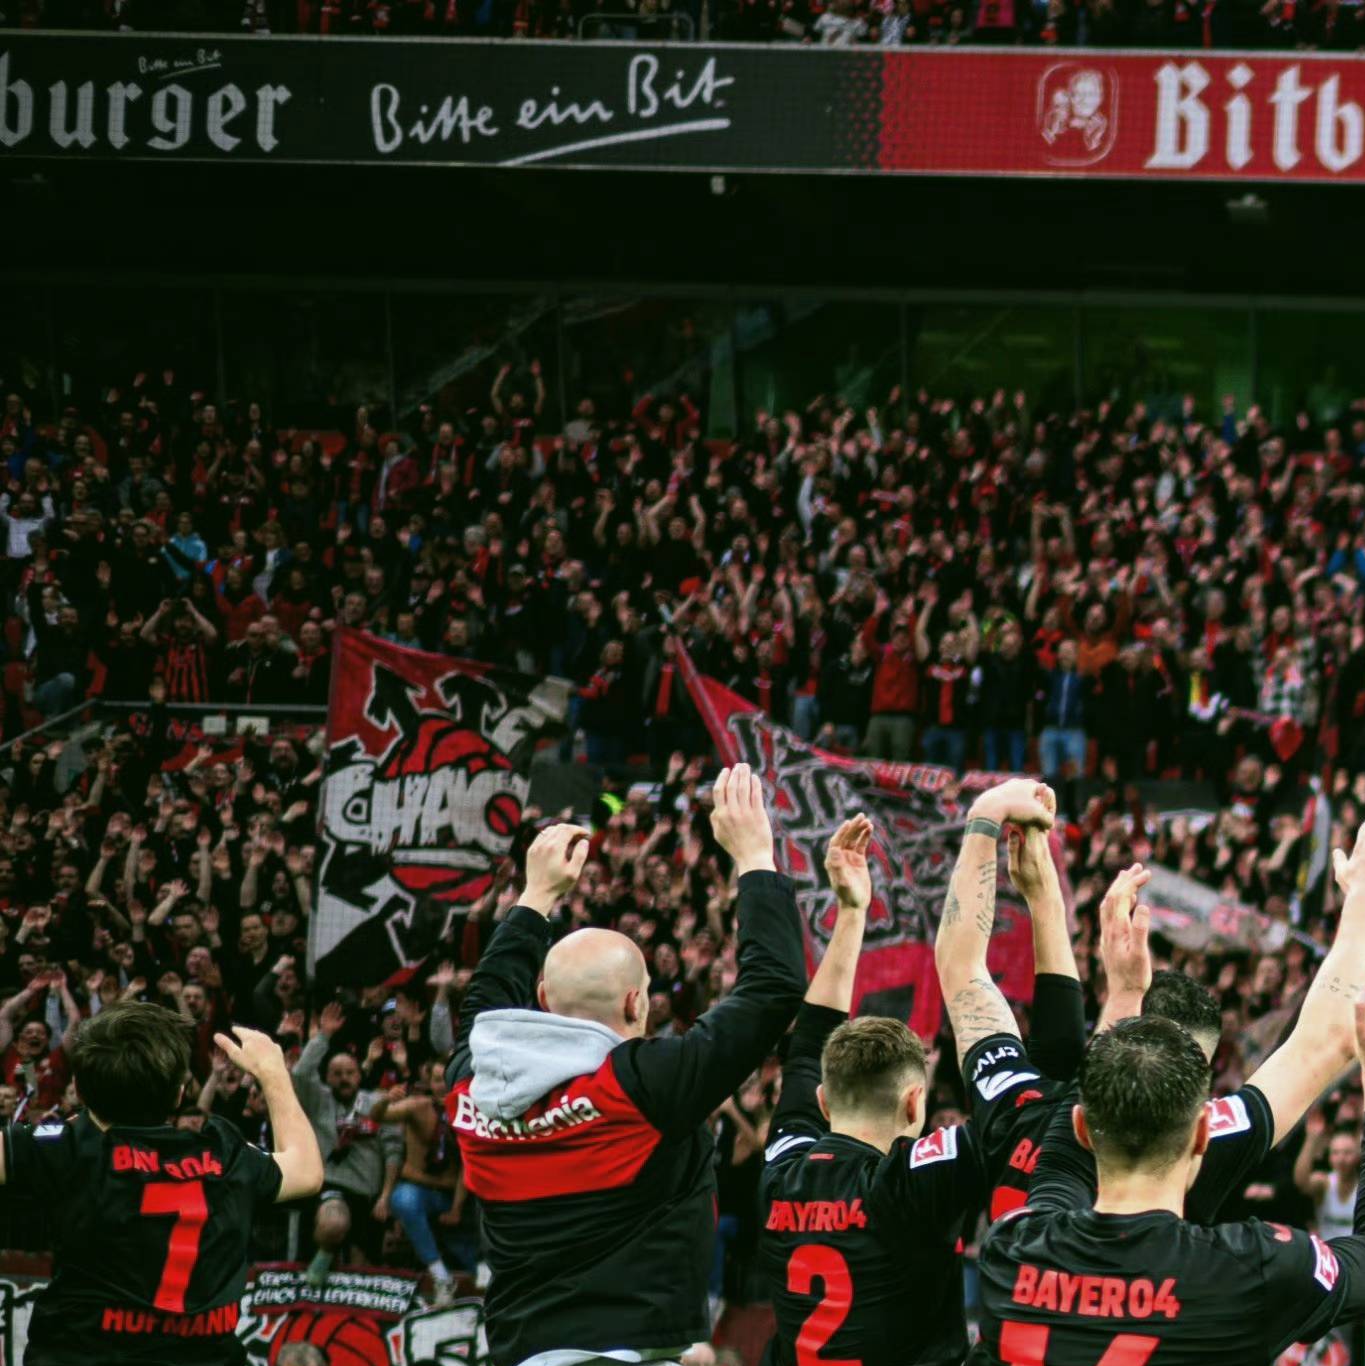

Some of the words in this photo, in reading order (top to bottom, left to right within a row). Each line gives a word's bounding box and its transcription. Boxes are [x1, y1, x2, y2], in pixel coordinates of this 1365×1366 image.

[370, 83, 498, 154] Bitte
[517, 86, 613, 130] ein
[140, 1180, 209, 1313] 7
